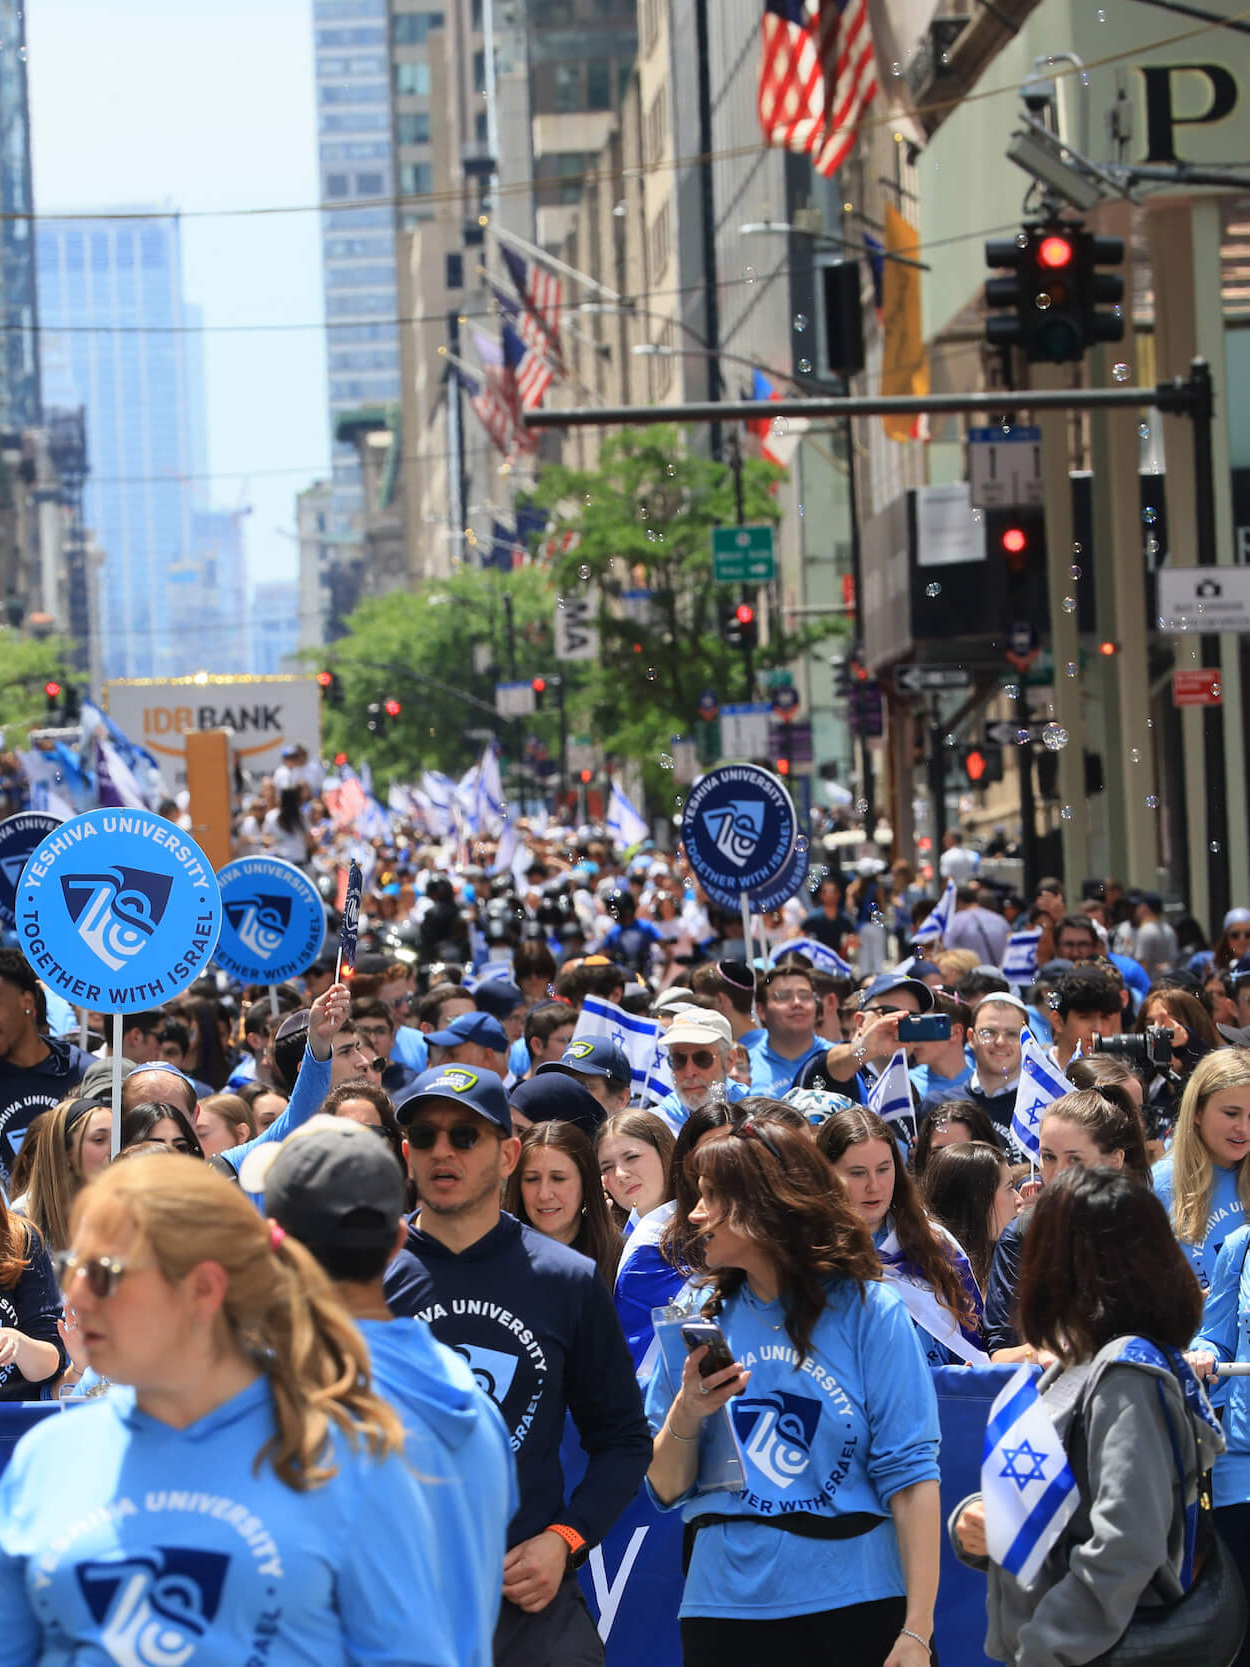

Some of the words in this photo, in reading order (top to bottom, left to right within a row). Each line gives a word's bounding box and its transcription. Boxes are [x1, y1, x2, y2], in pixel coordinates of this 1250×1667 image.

[197, 703, 284, 732] BANK
[684, 777, 719, 825] YESHIVA
[720, 769, 786, 807] UNIVERSITY
[24, 821, 98, 889] YESHIVA
[102, 817, 210, 889] UNIVERSITY
[242, 863, 315, 904] UNIVERSITY
[685, 837, 737, 888] TOGETHER
[737, 864, 770, 888] WITH
[768, 818, 791, 869] ISRAEL
[22, 910, 101, 1002] TOGETHER
[108, 978, 166, 1004] WITH
[166, 910, 213, 985] ISRAEL
[263, 962, 298, 980] WITH
[299, 916, 321, 963] ISRAEL
[23, 1095, 60, 1108] UNIVE
[452, 1299, 547, 1372] UNIVERSITY
[510, 1389, 543, 1453] SRAEL
[145, 1490, 284, 1579] UNIVERSITY
[779, 1492, 827, 1513] WITH
